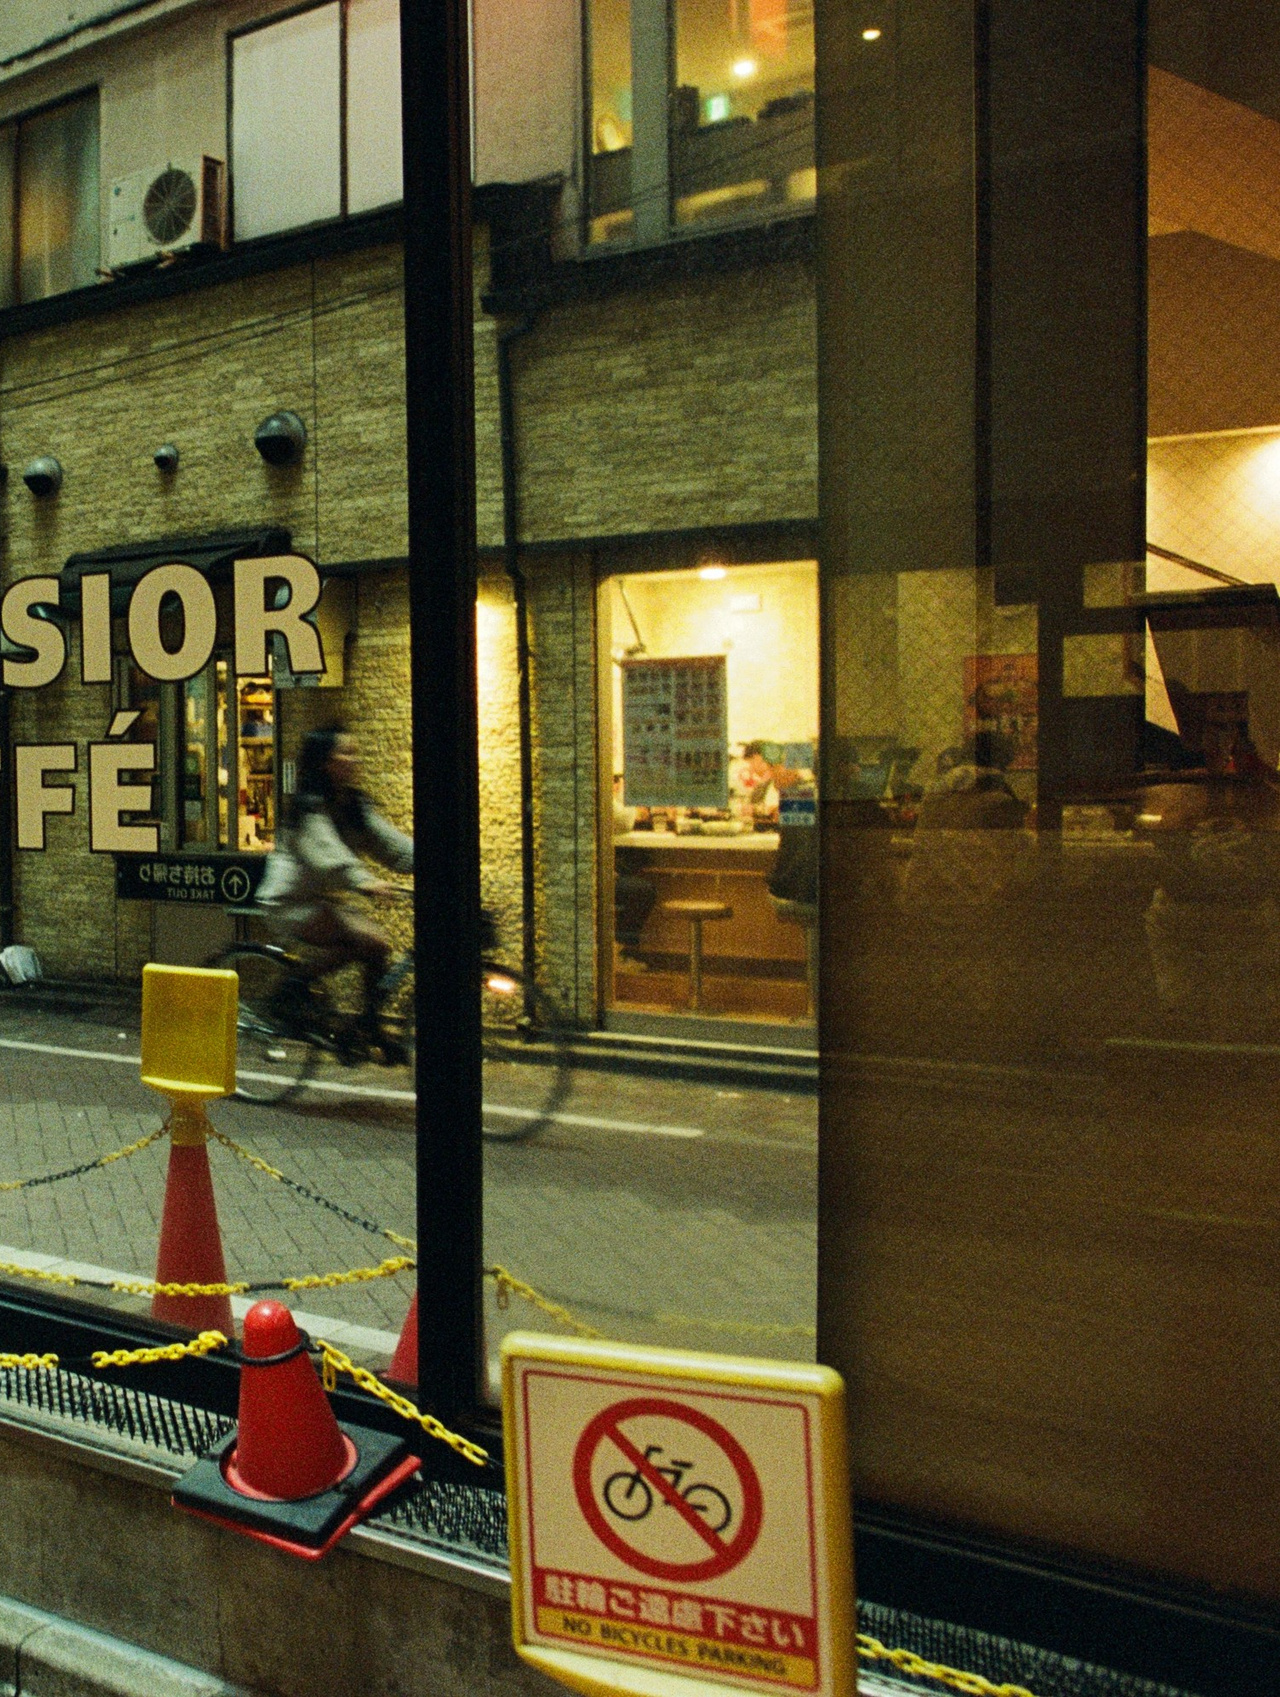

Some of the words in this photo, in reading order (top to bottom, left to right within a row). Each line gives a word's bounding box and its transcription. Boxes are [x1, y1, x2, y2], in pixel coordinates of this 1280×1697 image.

[544, 1574, 806, 1648] 駐輪ご遠慮下さい
[562, 1616, 592, 1636] NO
[600, 1622, 689, 1655] BICYCLES
[696, 1641, 787, 1676] PARKING
